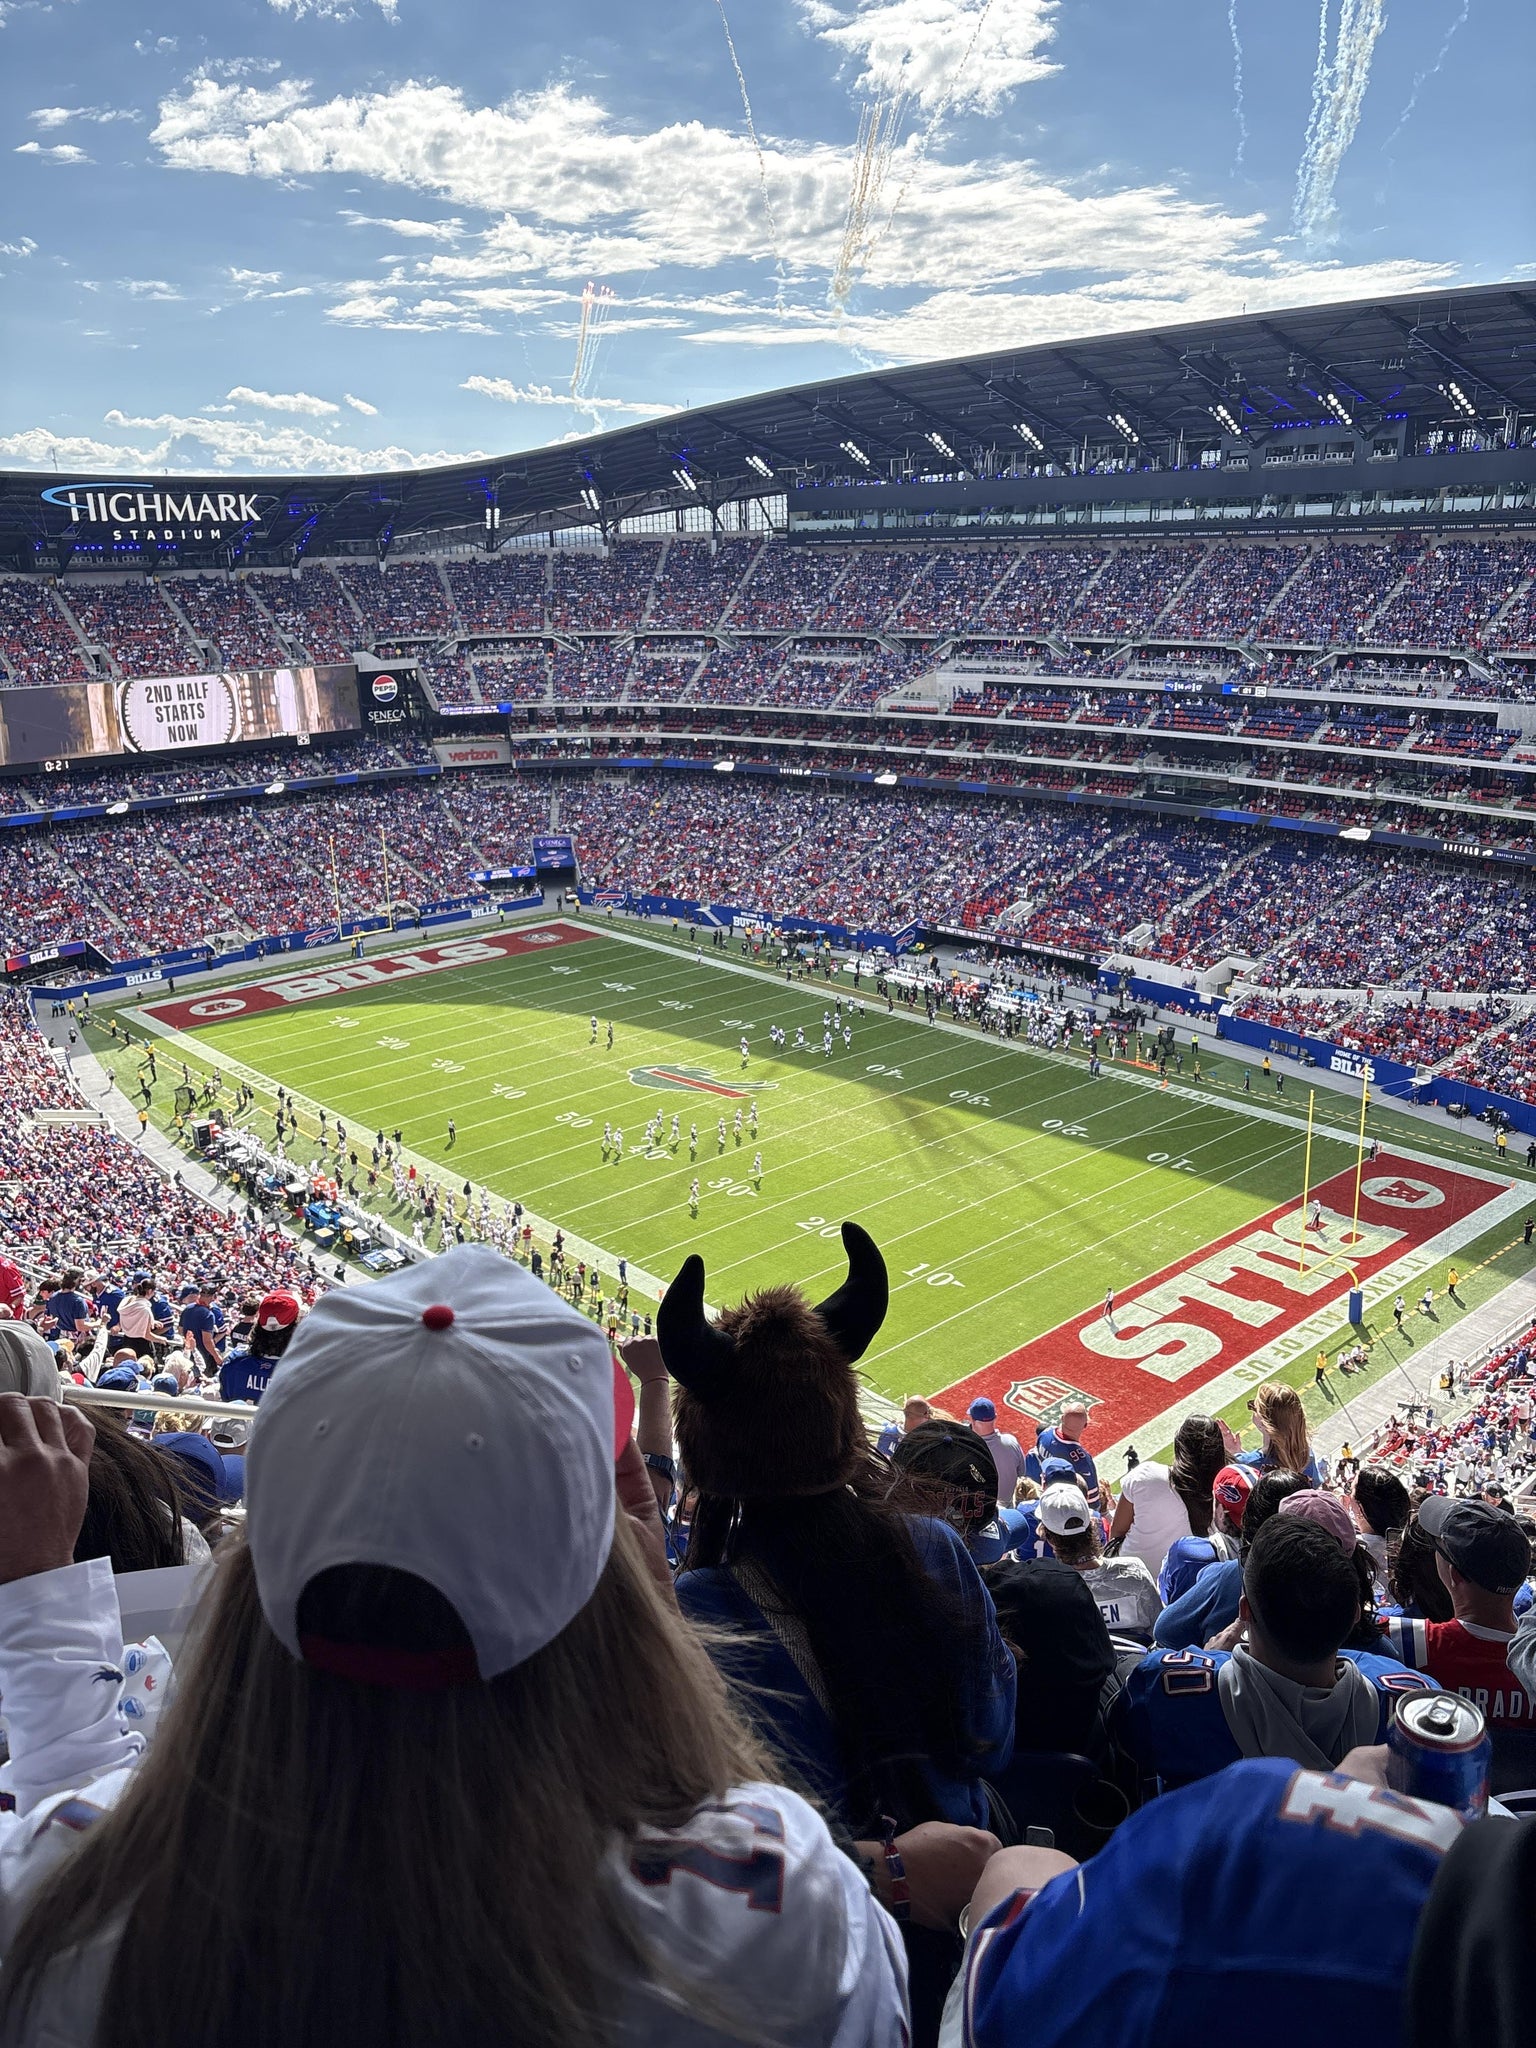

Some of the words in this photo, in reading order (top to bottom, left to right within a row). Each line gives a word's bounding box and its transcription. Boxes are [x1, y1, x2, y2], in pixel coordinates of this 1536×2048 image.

[68, 492, 262, 522] HIGHMARK
[113, 529, 221, 541] STADIUM
[145, 685, 172, 703] 2ND
[177, 682, 208, 700] HALF
[155, 702, 205, 723] STARTS
[368, 709, 407, 721] SENECA
[168, 724, 198, 743] NOW
[448, 748, 499, 762] verizon
[1443, 842, 1480, 856] BUFFALO
[471, 905, 498, 918] BILLS
[732, 915, 773, 933] BUFFALO
[29, 948, 59, 964] BILLS
[125, 970, 163, 987] BILLS
[261, 942, 509, 1002] BILLS
[329, 1016, 360, 1028] 10
[376, 1036, 410, 1050] 20
[431, 1058, 465, 1074] 30
[1335, 1049, 1352, 1059] HOME
[1361, 1056, 1373, 1065] THE
[866, 1064, 903, 1078] 40
[1330, 1056, 1376, 1082] BILLS
[490, 1082, 527, 1100] 40
[949, 1090, 988, 1105] 30
[555, 1111, 594, 1128] 50
[1041, 1118, 1086, 1136] 20
[1146, 1151, 1192, 1171] 10
[707, 1177, 752, 1197] 30
[795, 1215, 842, 1239] 20
[1400, 1256, 1429, 1272] IT
[902, 1262, 955, 1288] 10
[1078, 1206, 1410, 1384] BILLS
[1343, 1271, 1408, 1307] TAK
[1297, 1310, 1344, 1336] ALL
[1273, 1338, 1304, 1360] OF
[1233, 1359, 1274, 1382] US
[1012, 1380, 1073, 1411] NFL
[1069, 1448, 1087, 1462] 95
